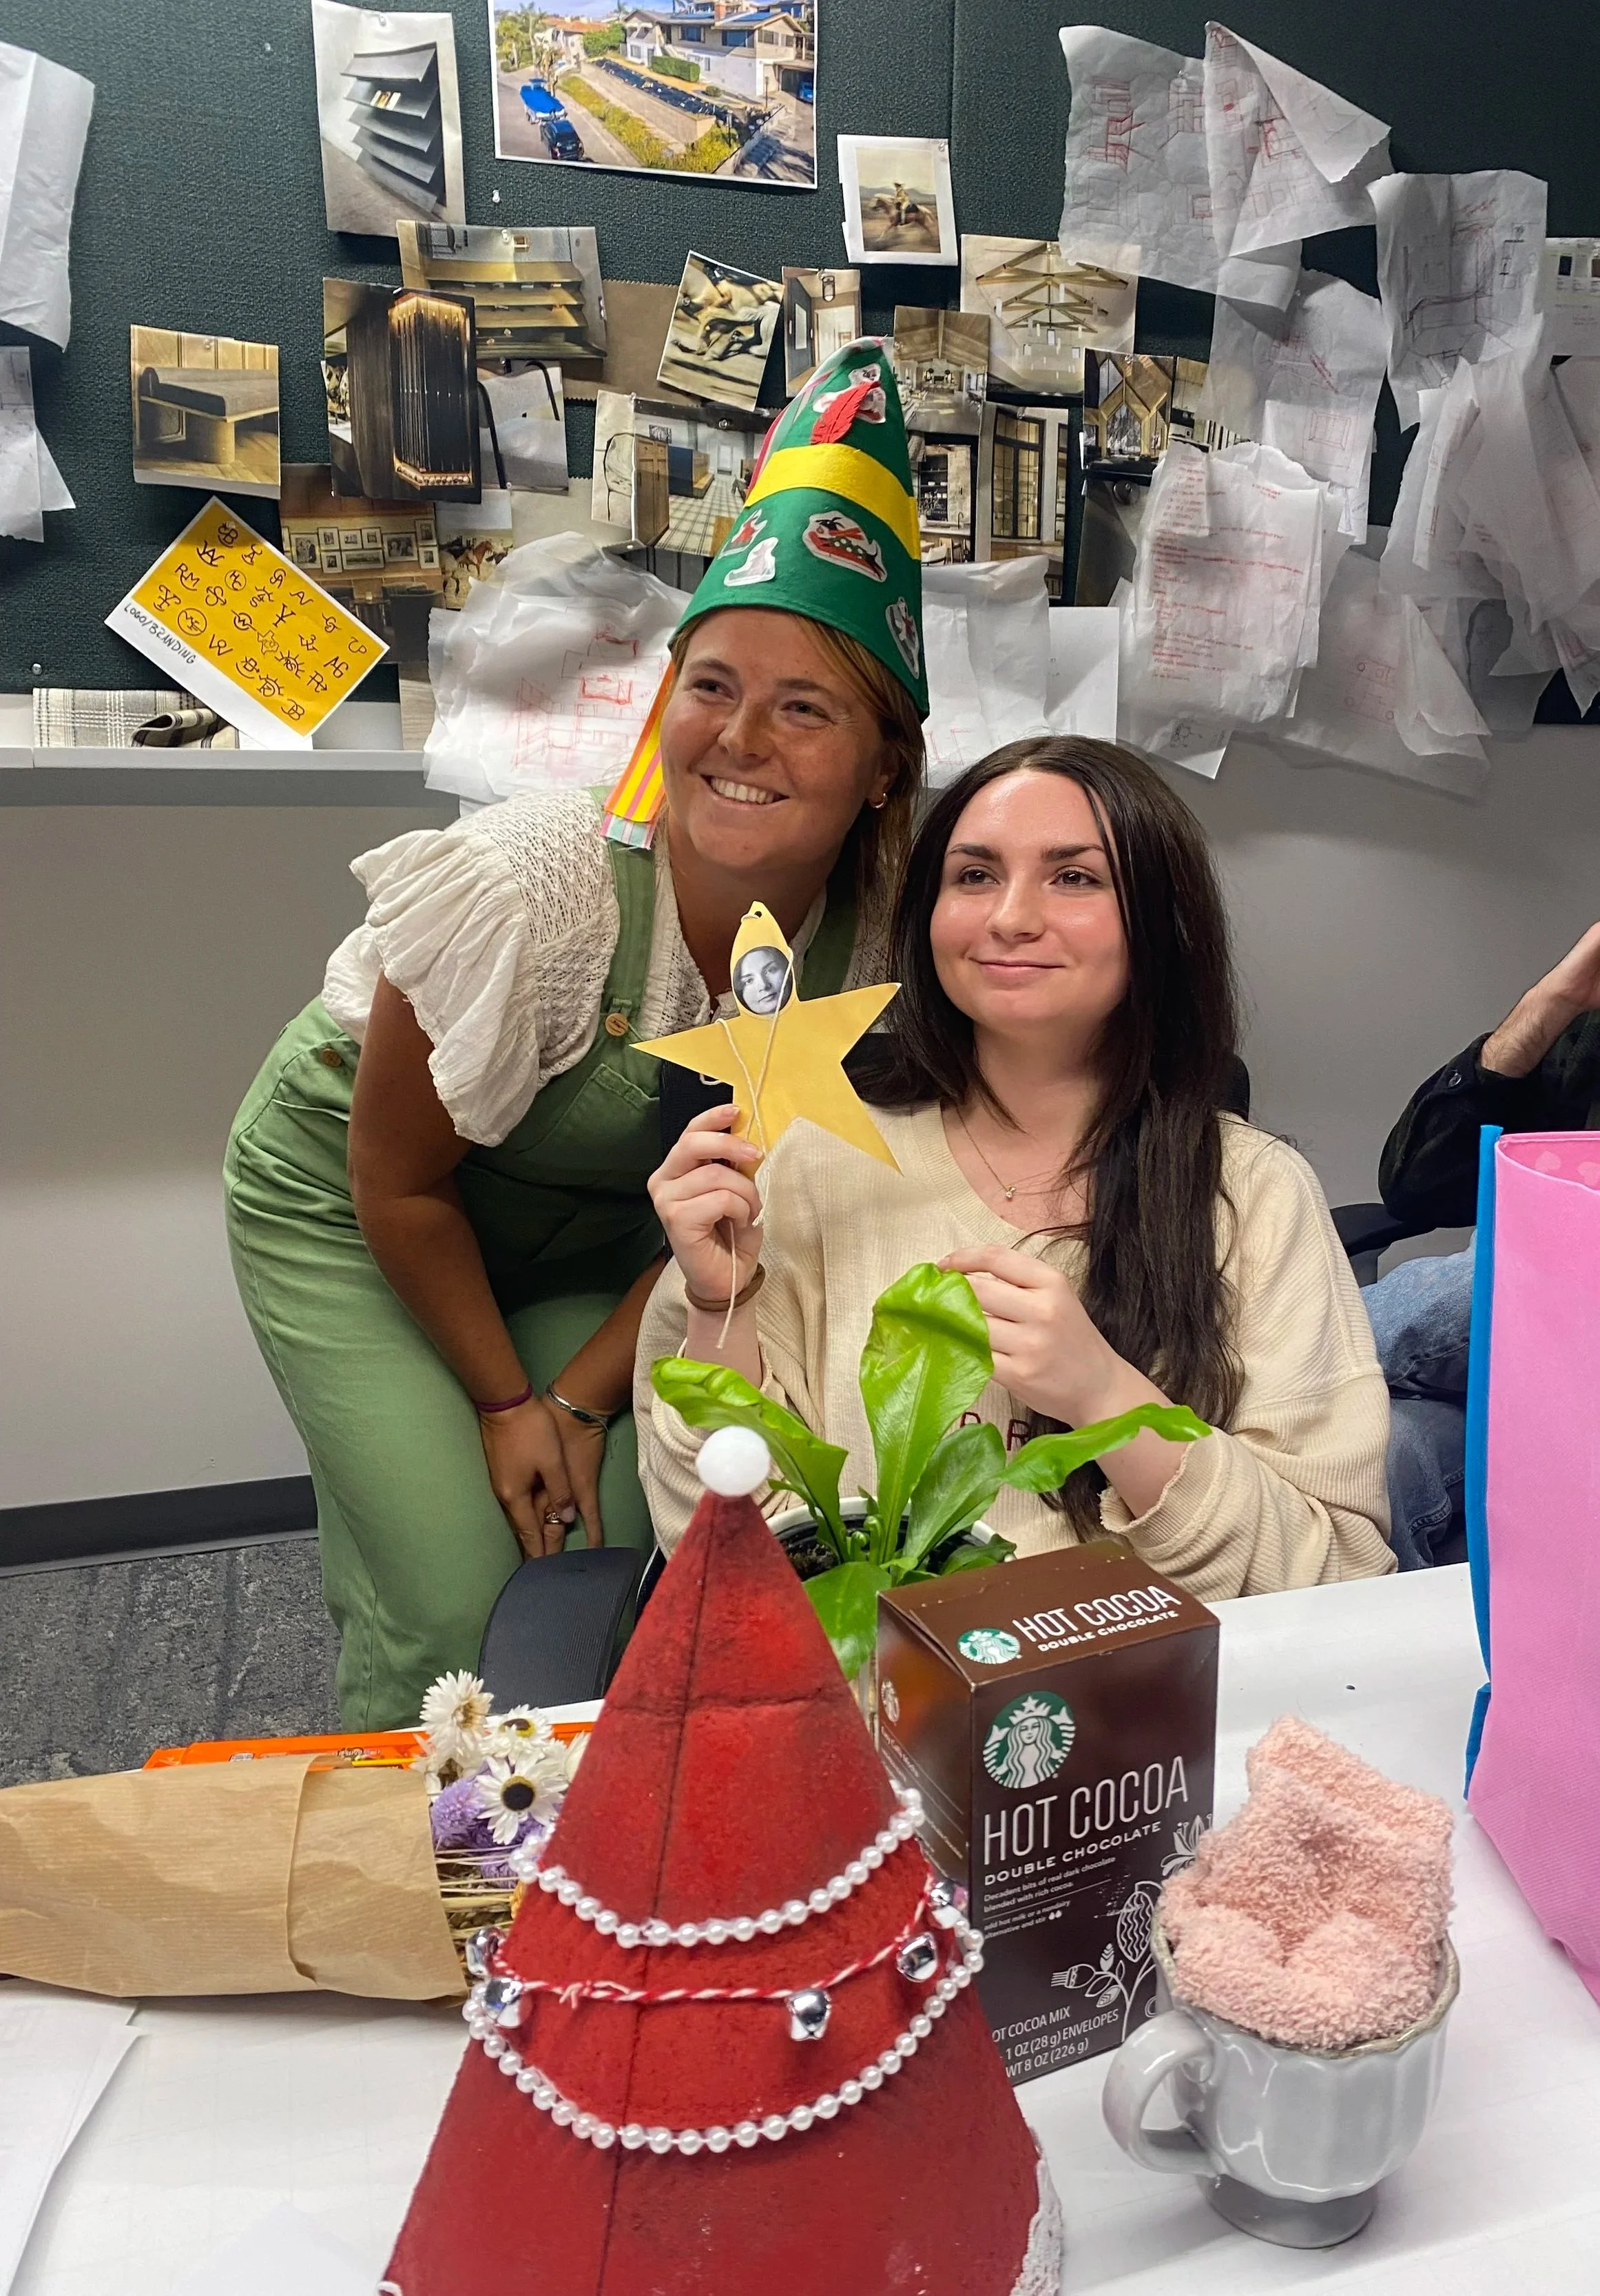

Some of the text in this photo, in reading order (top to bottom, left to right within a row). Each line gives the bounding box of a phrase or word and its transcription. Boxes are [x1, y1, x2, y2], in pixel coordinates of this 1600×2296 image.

[124, 603, 196, 664] LOGO/BRANDING
[1012, 1585, 1182, 1642] HOT COCOA
[1037, 1611, 1180, 1652] DOUBLE CHOCOLATE
[984, 1795, 1058, 1865] HOT
[1069, 1755, 1189, 1839] COCOA
[984, 1821, 1161, 1886] DOUBLE CHOCOLATE
[984, 1857, 1116, 1902] Decadent bits of real dark chocolate
[984, 1881, 1074, 1913] blended with rich cocoa.
[984, 1920, 998, 1930] add
[999, 1918, 1011, 1926] hot
[1012, 1913, 1026, 1922] milk
[1042, 1901, 1071, 1913] nondairy
[1021, 1919, 1035, 1928] and
[991, 2006, 1071, 2042] OT COCOA MIX
[1006, 2009, 1119, 2060] 1 OZ (28 g) ENVELOPES
[1005, 2038, 1090, 2078] WT 8 OZ (226 g)
